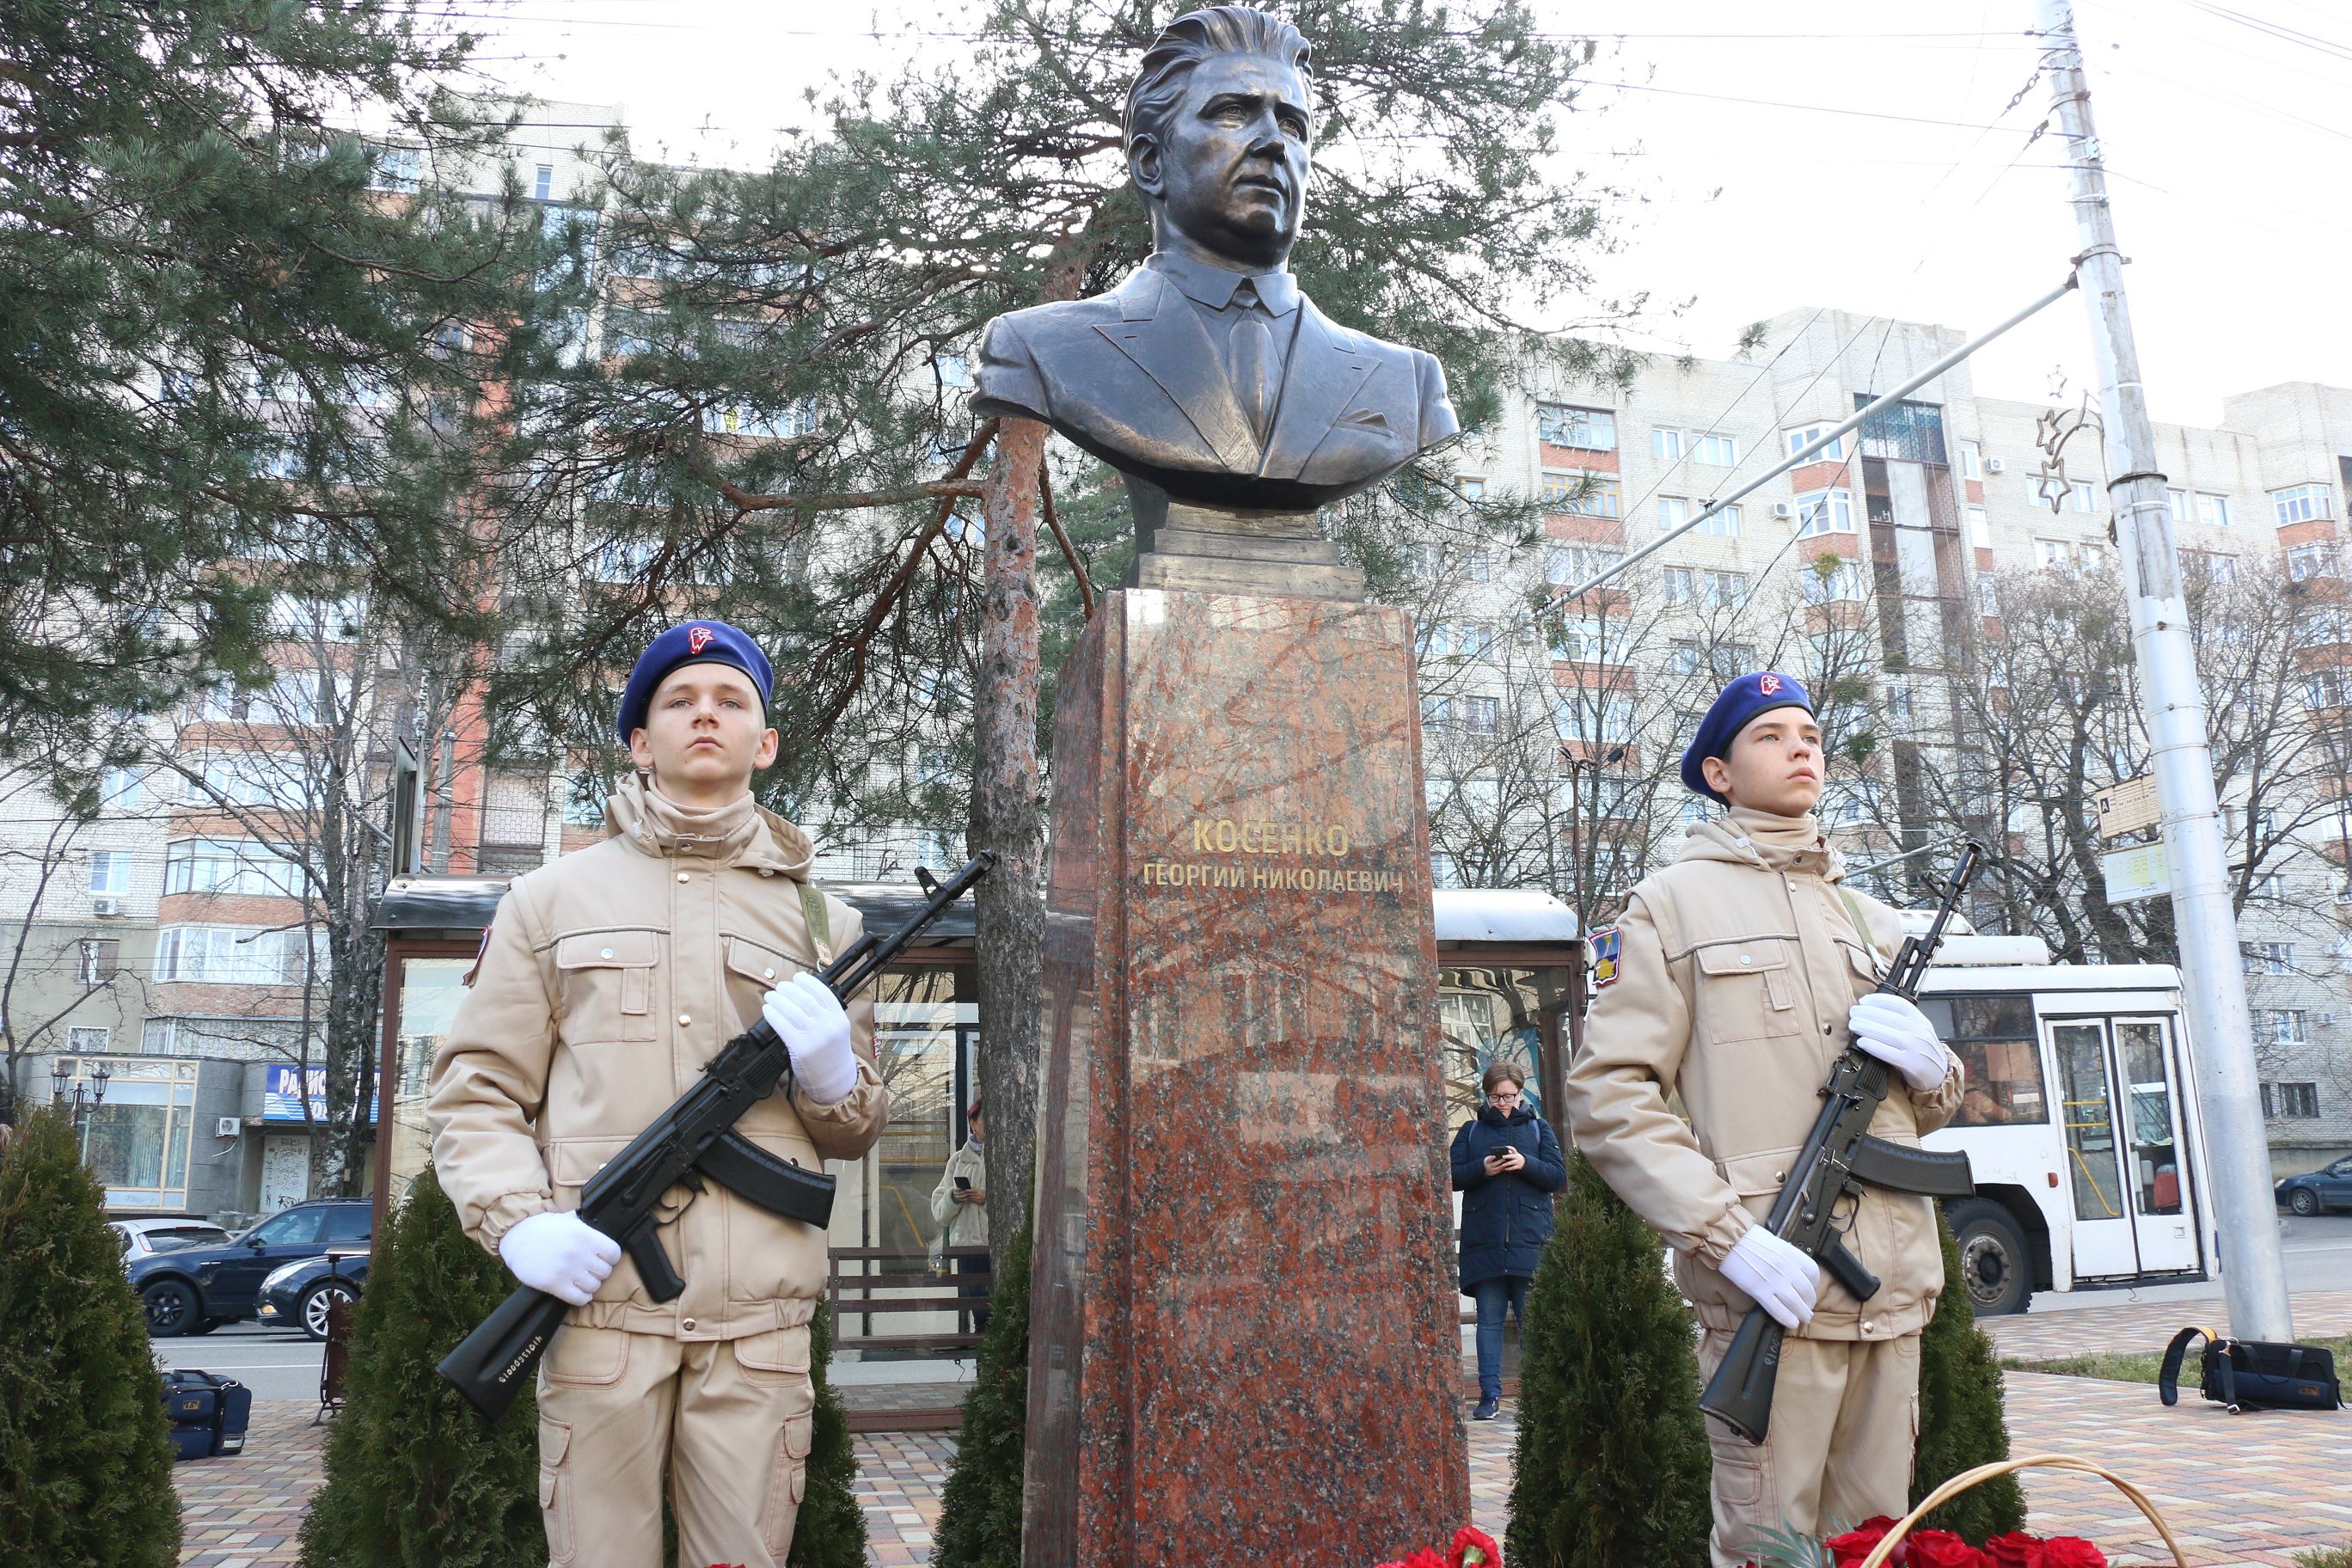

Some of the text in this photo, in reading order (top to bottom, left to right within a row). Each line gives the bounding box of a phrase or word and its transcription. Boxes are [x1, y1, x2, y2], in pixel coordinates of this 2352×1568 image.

[1192, 818, 1349, 857] КОСЕНКО
[1142, 860, 1403, 895] ГЕОРГИЙ НИКОЛАЕВИЧ
